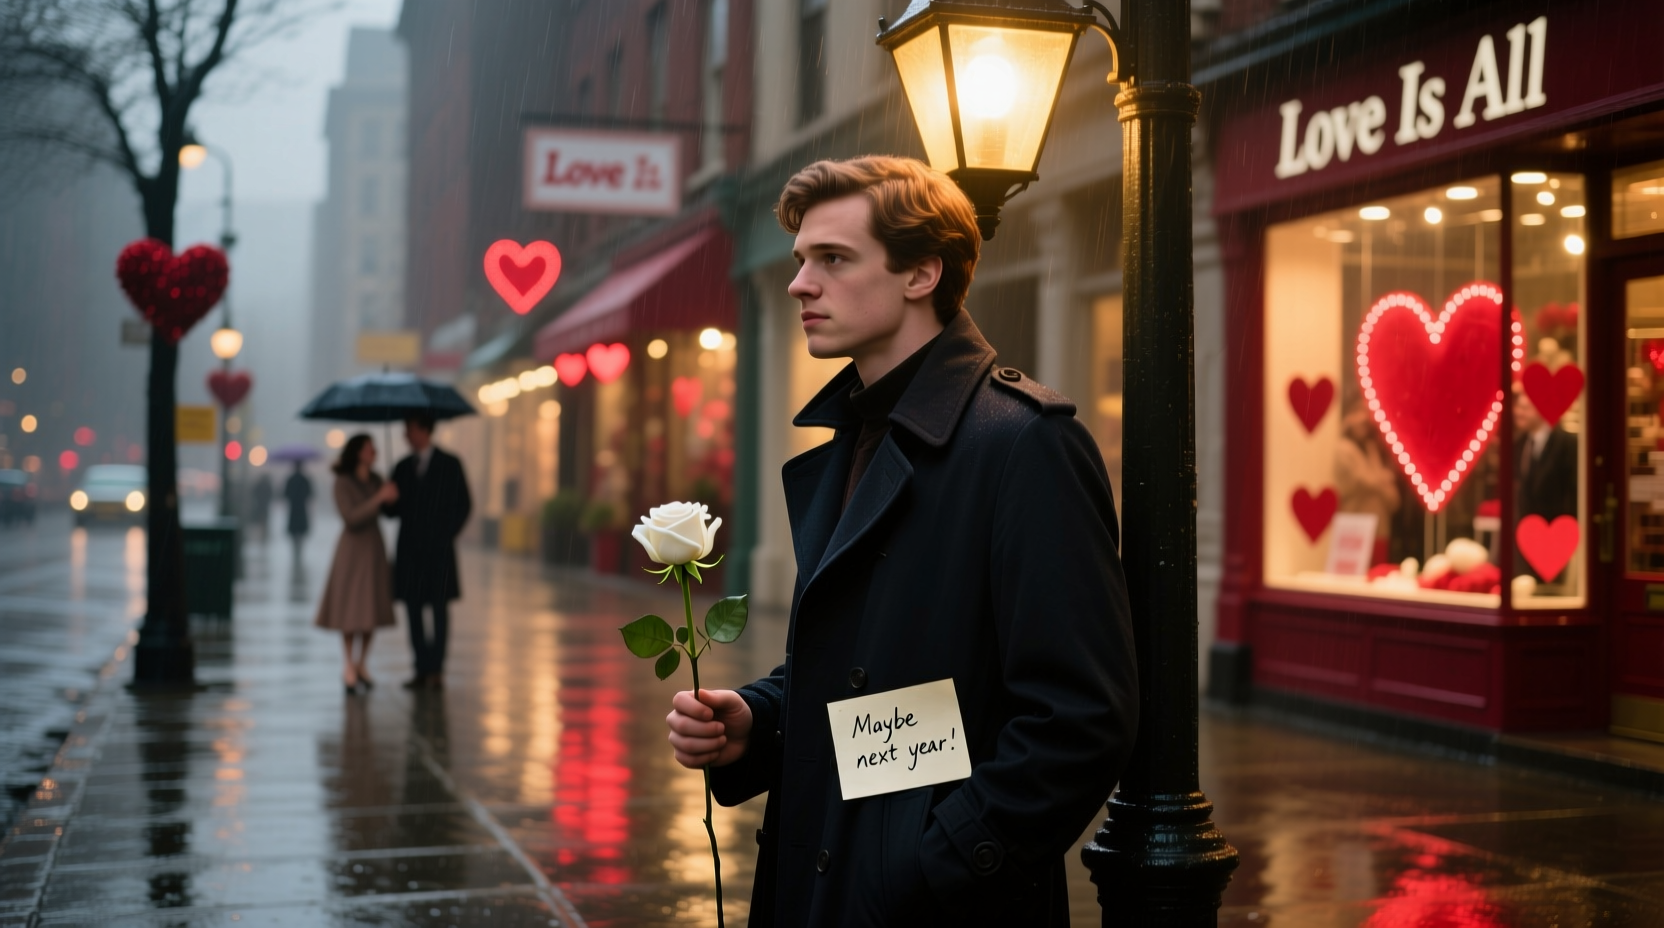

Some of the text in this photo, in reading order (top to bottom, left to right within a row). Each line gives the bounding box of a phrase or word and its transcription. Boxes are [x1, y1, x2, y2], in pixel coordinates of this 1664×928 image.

[1274, 15, 1548, 180] Love Is All
[543, 150, 625, 190] Love
[852, 706, 918, 744] Maybe
[856, 727, 955, 771] next year!
